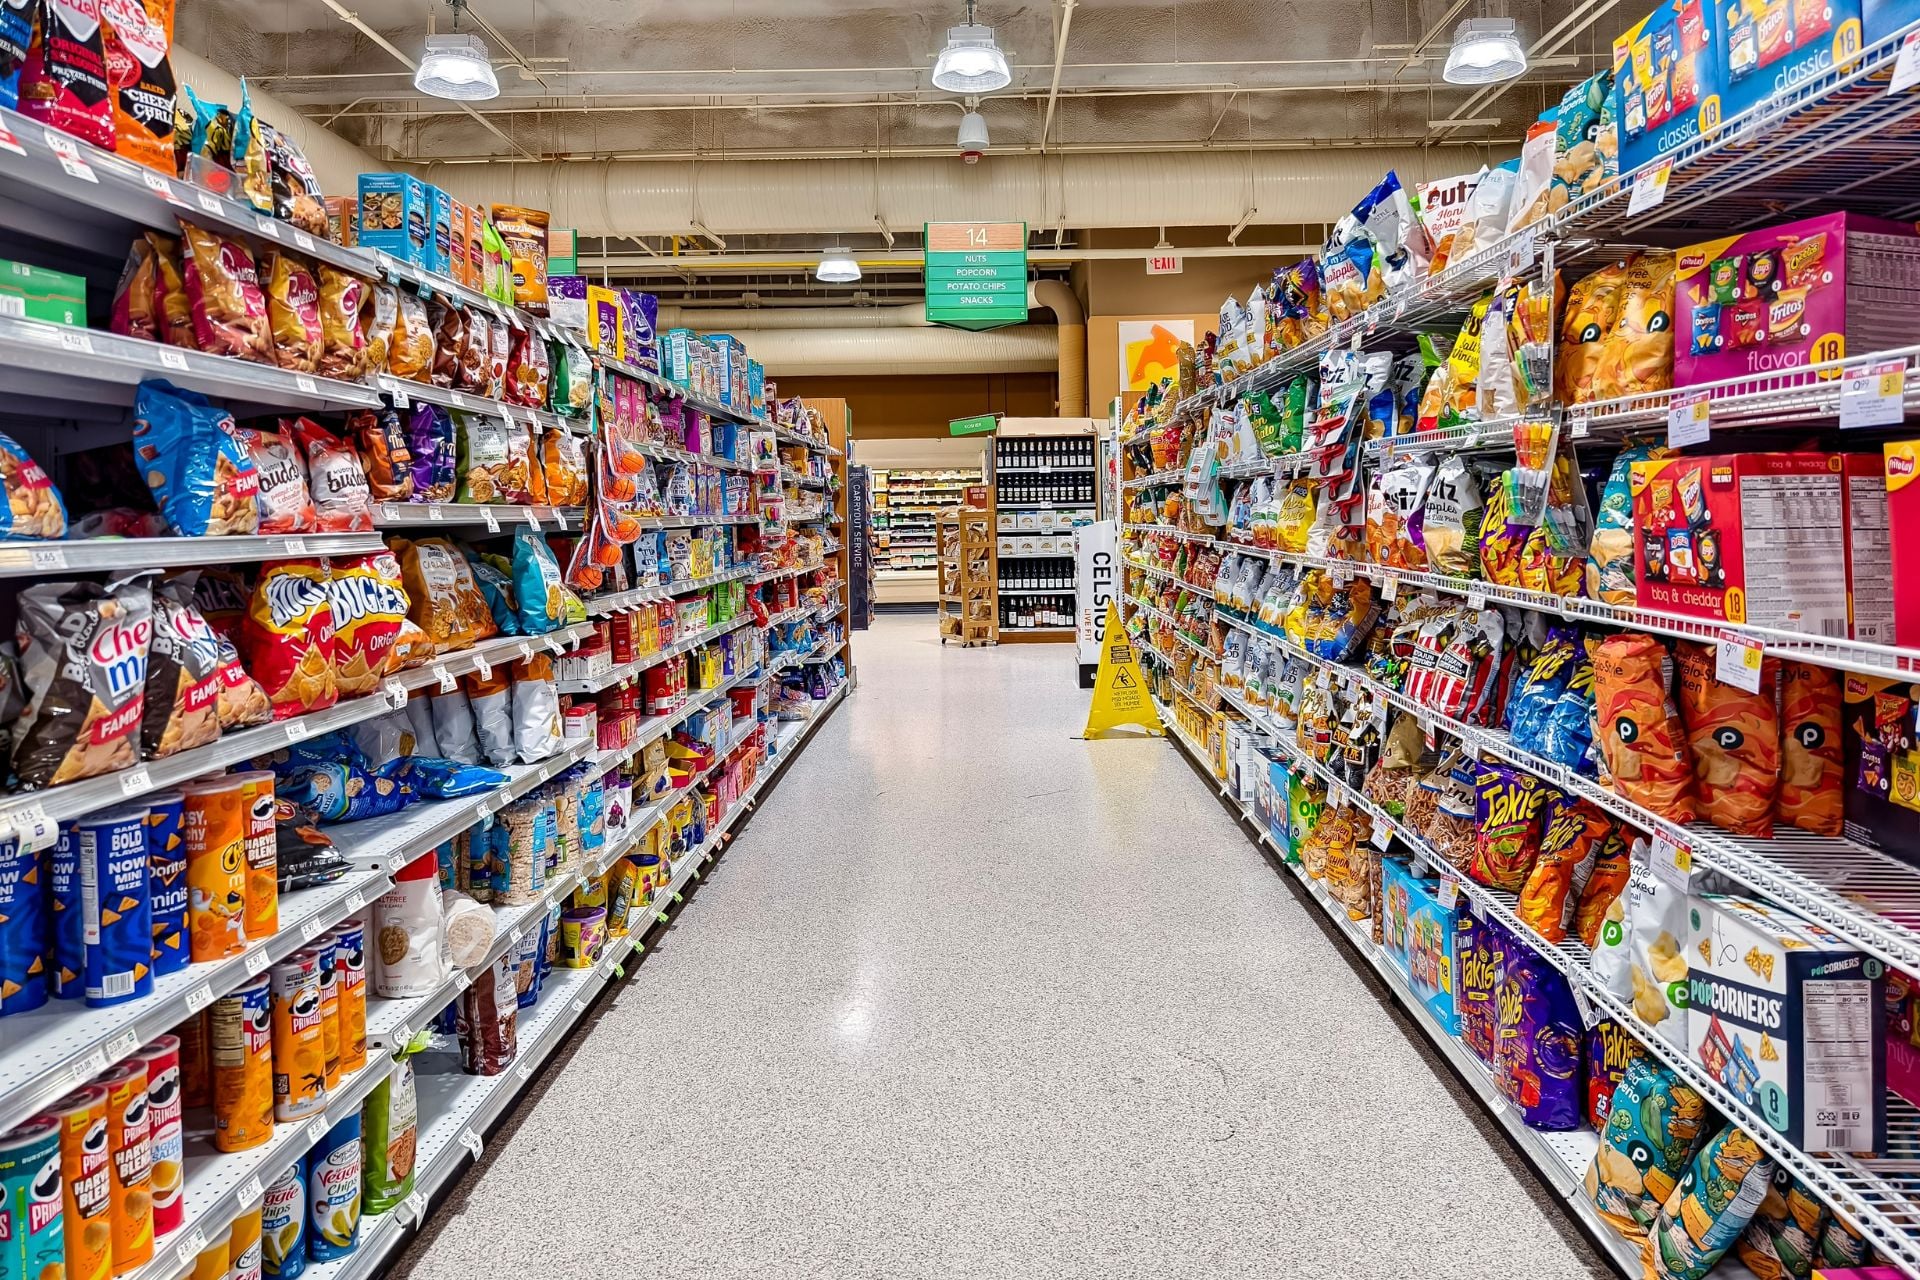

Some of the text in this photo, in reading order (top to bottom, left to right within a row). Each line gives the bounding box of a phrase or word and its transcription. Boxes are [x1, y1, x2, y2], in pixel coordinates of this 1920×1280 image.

[1840, 27, 1855, 57] 18
[1775, 49, 1829, 91] classic
[1704, 102, 1716, 127] 18
[1658, 118, 1697, 152] classic
[966, 228, 988, 246] 14
[1790, 243, 1819, 270] Cheetos
[956, 268, 997, 276] POPCORN
[947, 282, 1006, 290] POTATO CHIPS
[960, 296, 993, 304] SNACKS
[1771, 300, 1803, 324] Fritos
[1747, 350, 1806, 371] flavor
[1818, 340, 1839, 361] 18
[852, 484, 861, 529] CARRYOUT
[853, 531, 862, 568] SERVICE
[326, 576, 409, 630] BUGLES
[1652, 587, 1722, 608] bbq & cheddar
[1729, 592, 1741, 613] 18
[1480, 784, 1546, 833] Takis
[111, 830, 142, 851] BOLD
[108, 856, 146, 875] NOW
[114, 869, 143, 885] MINI
[1461, 949, 1496, 993] Takis
[1869, 961, 1877, 973] 8
[1769, 1088, 1779, 1114] 8
[327, 1177, 358, 1196] Chips
